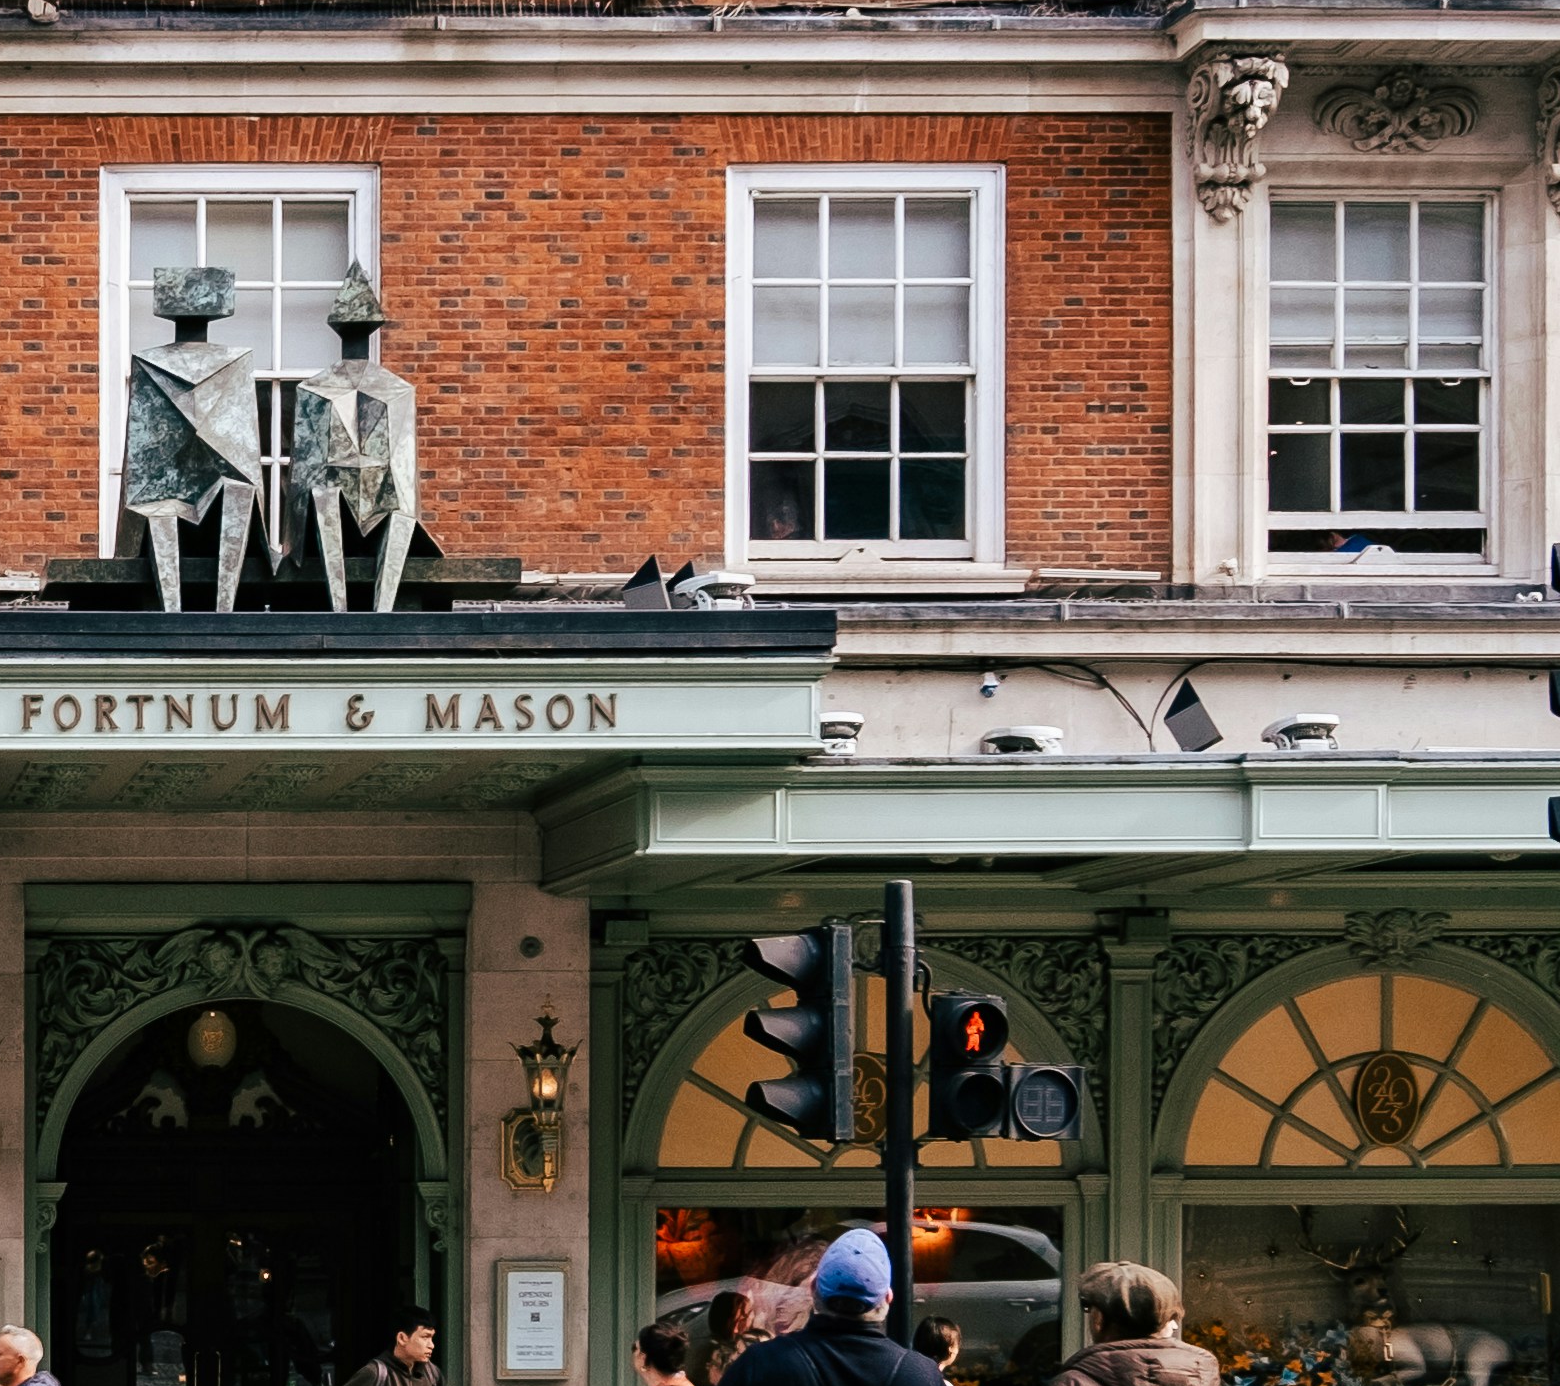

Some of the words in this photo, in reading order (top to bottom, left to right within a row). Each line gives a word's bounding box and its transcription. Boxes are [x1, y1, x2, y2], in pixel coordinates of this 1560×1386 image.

[21, 693, 292, 732] FORTNUM
[345, 693, 375, 732] &
[425, 693, 618, 731] MASON
